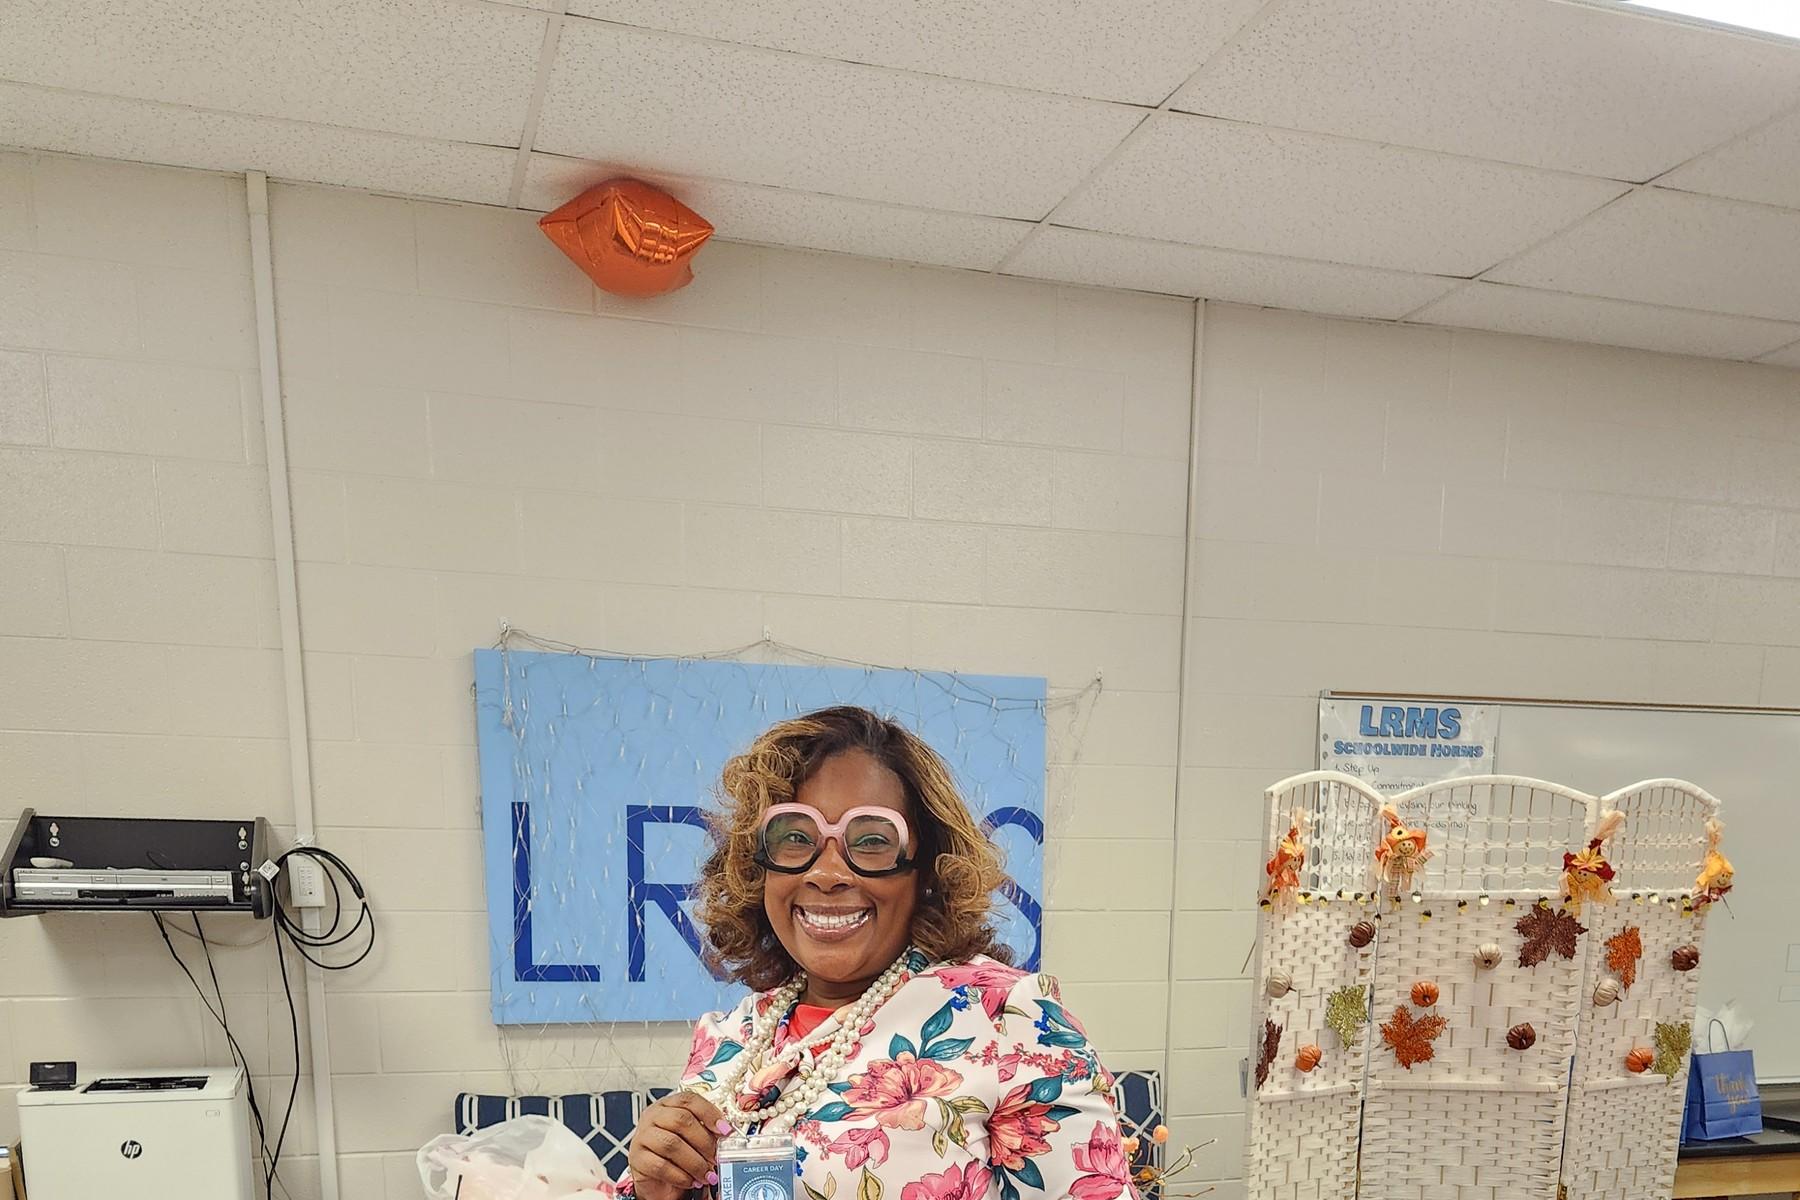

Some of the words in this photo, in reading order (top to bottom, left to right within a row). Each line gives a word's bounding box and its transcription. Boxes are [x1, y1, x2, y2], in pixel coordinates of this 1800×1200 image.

[1360, 705, 1462, 739] LRMS
[1334, 740, 1427, 757] SCHOOLWIDE
[1430, 743, 1484, 758] NORMS
[1343, 762, 1365, 776] Step
[1368, 763, 1380, 776] Up
[124, 1140, 141, 1159] hp
